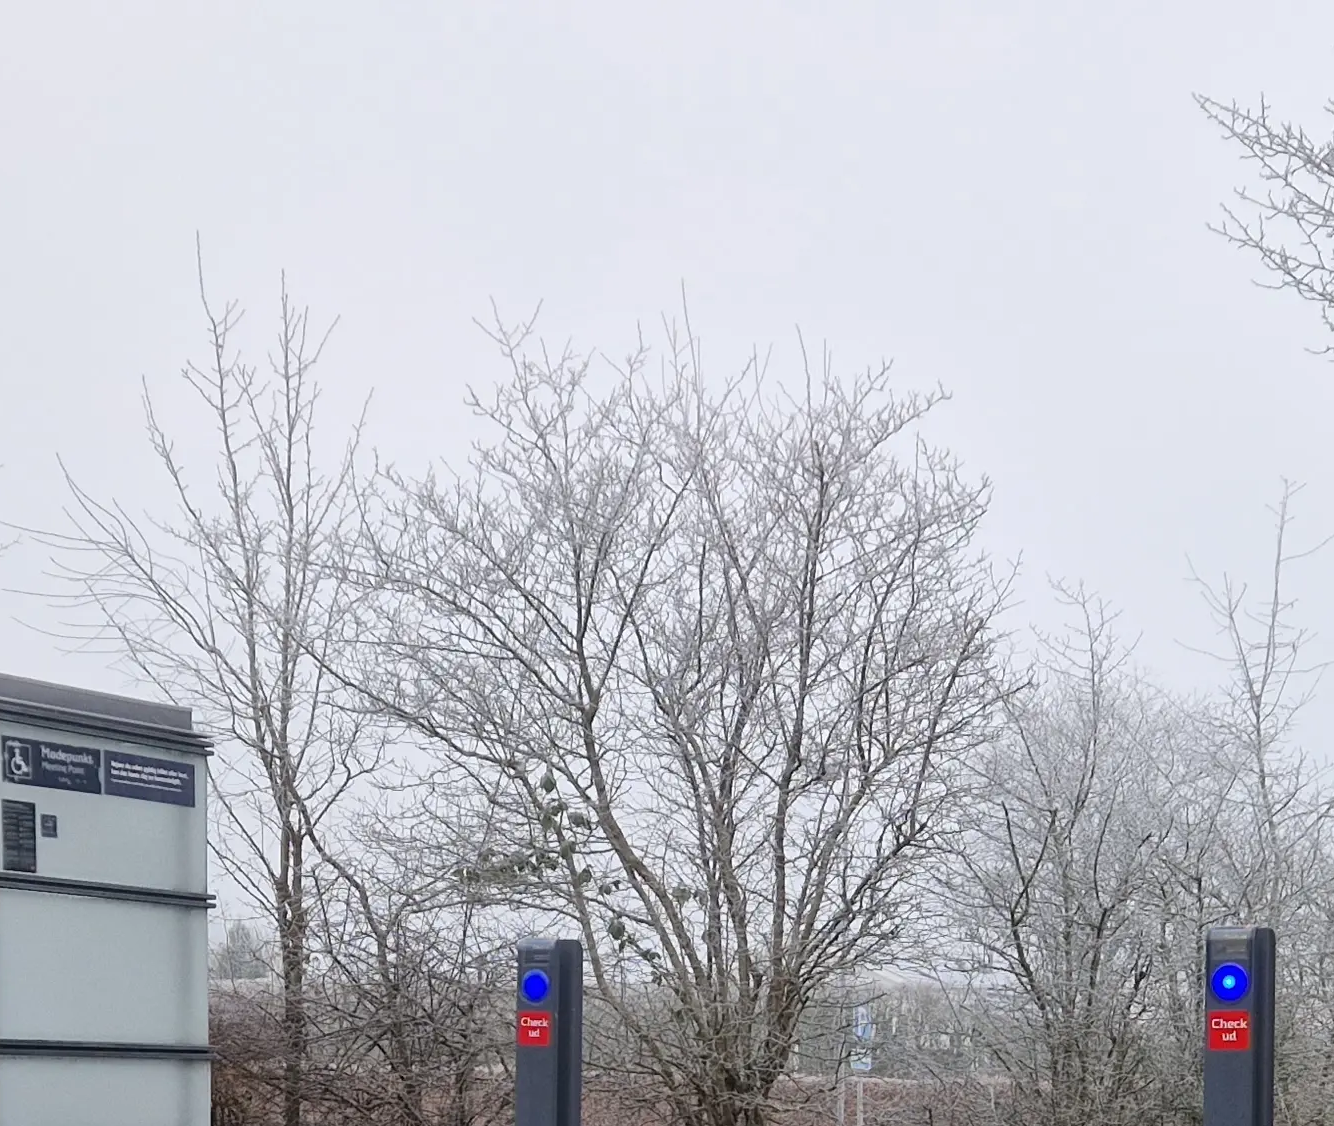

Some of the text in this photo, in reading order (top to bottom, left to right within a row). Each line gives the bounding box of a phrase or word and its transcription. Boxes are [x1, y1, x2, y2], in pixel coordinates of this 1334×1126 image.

[520, 1017, 549, 1028] Check
[1211, 1018, 1248, 1029] Check
[528, 1029, 540, 1038] ud
[1222, 1030, 1237, 1041] ud
